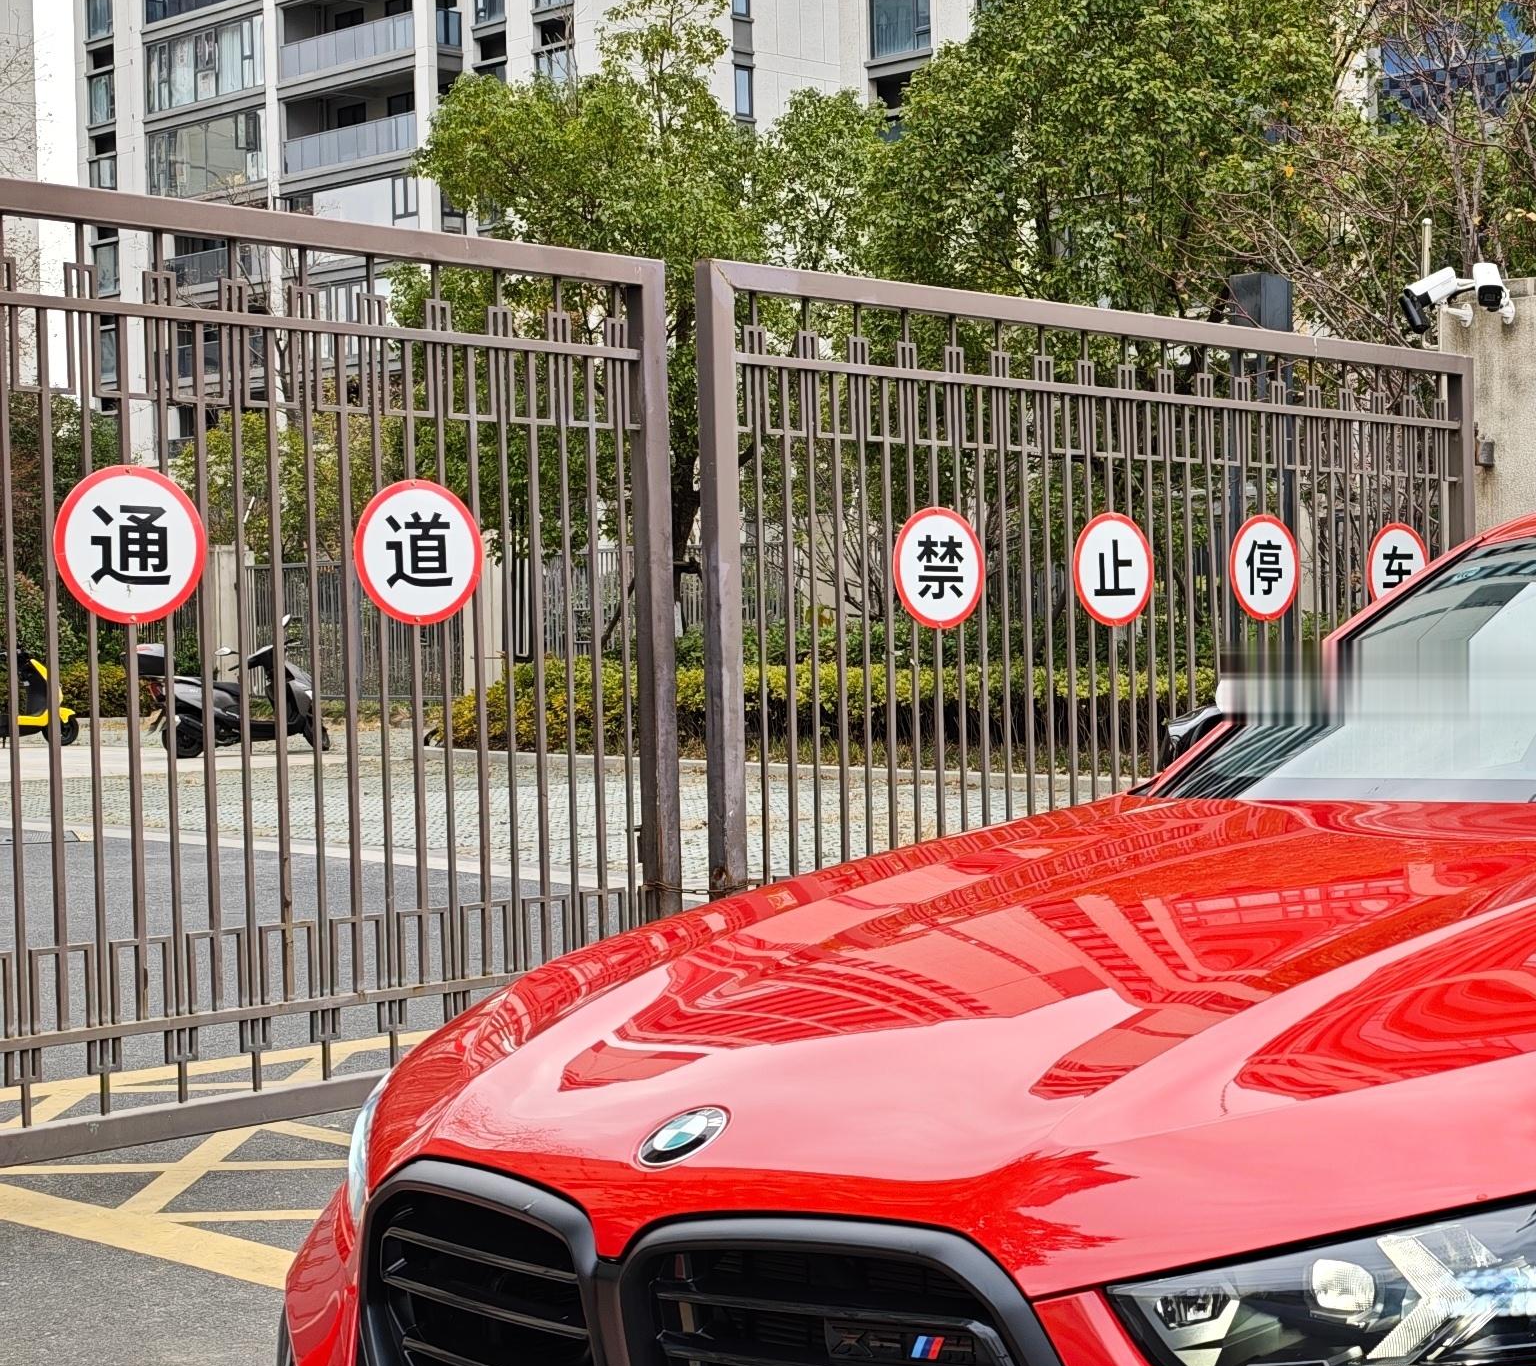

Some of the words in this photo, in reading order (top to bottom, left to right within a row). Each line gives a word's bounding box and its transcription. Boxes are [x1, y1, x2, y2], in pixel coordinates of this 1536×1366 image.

[90, 504, 172, 586] 通
[384, 511, 454, 588] 道
[915, 533, 965, 601] 禁
[1093, 538, 1137, 597] 止
[1244, 540, 1283, 597] 停
